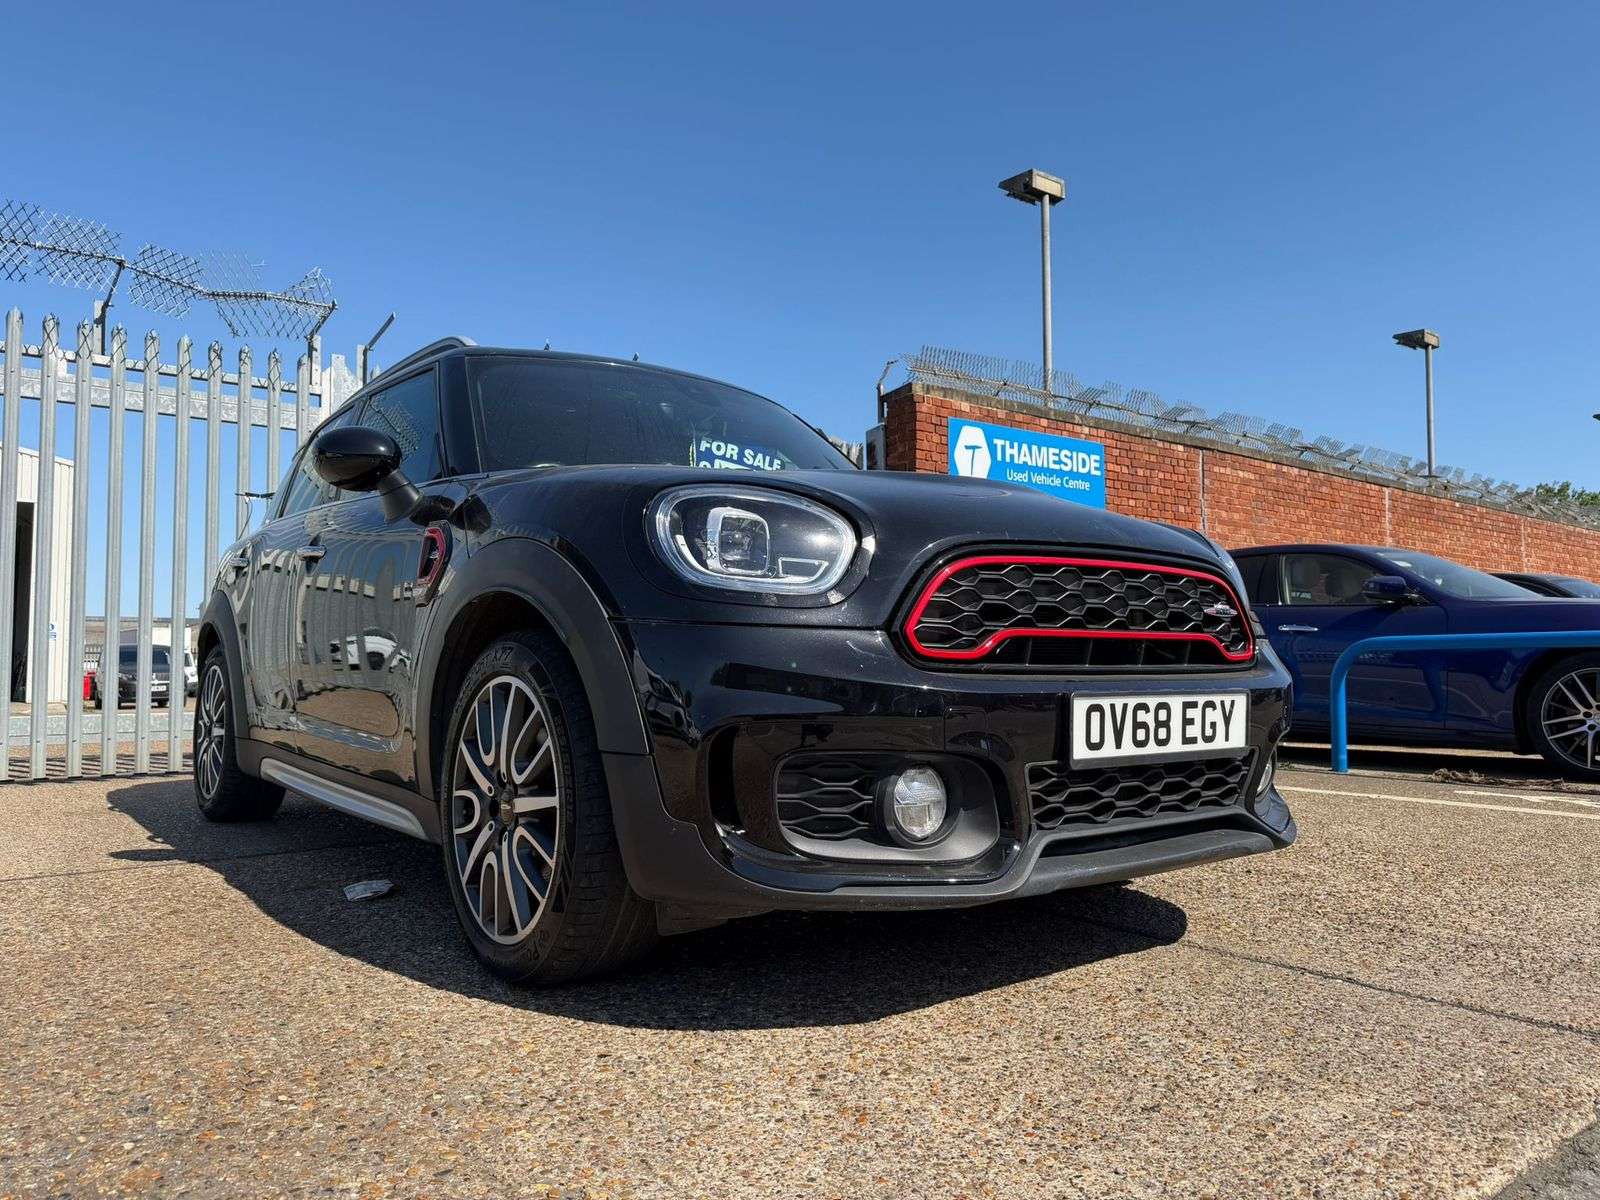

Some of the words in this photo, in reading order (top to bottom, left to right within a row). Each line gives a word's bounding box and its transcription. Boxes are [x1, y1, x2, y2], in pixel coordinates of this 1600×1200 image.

[700, 440, 739, 460] FOR
[743, 448, 781, 471] SALE
[993, 438, 1101, 476] THAMESIDE
[1006, 468, 1029, 483] Used
[1030, 471, 1062, 488] Vehicle
[1063, 477, 1090, 492] Centre
[1085, 702, 1172, 751] OV68
[1181, 699, 1235, 744] EGY
